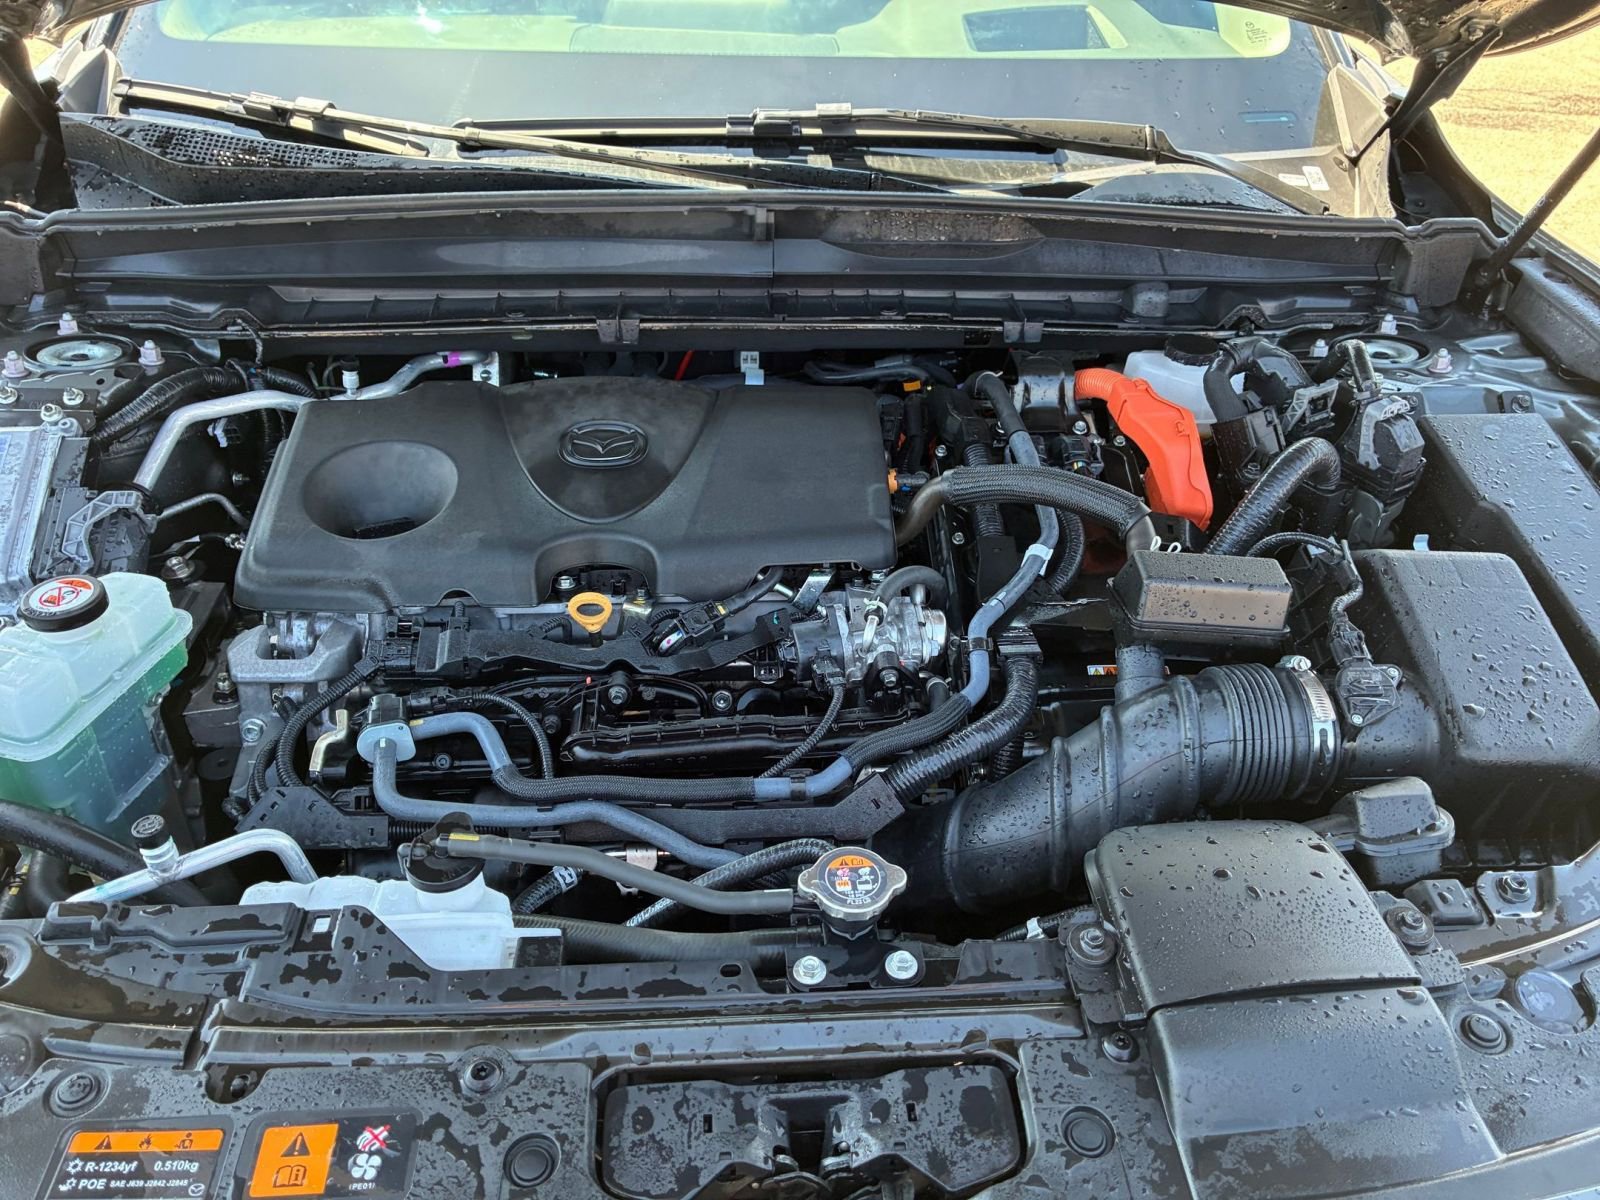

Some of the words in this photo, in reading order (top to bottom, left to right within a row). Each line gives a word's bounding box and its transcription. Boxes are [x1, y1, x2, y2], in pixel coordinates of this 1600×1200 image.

[84, 1161, 138, 1174] R-1234yf
[154, 1160, 199, 1173] 0.510kg
[78, 1179, 107, 1190] POE
[109, 1180, 126, 1188] SAE
